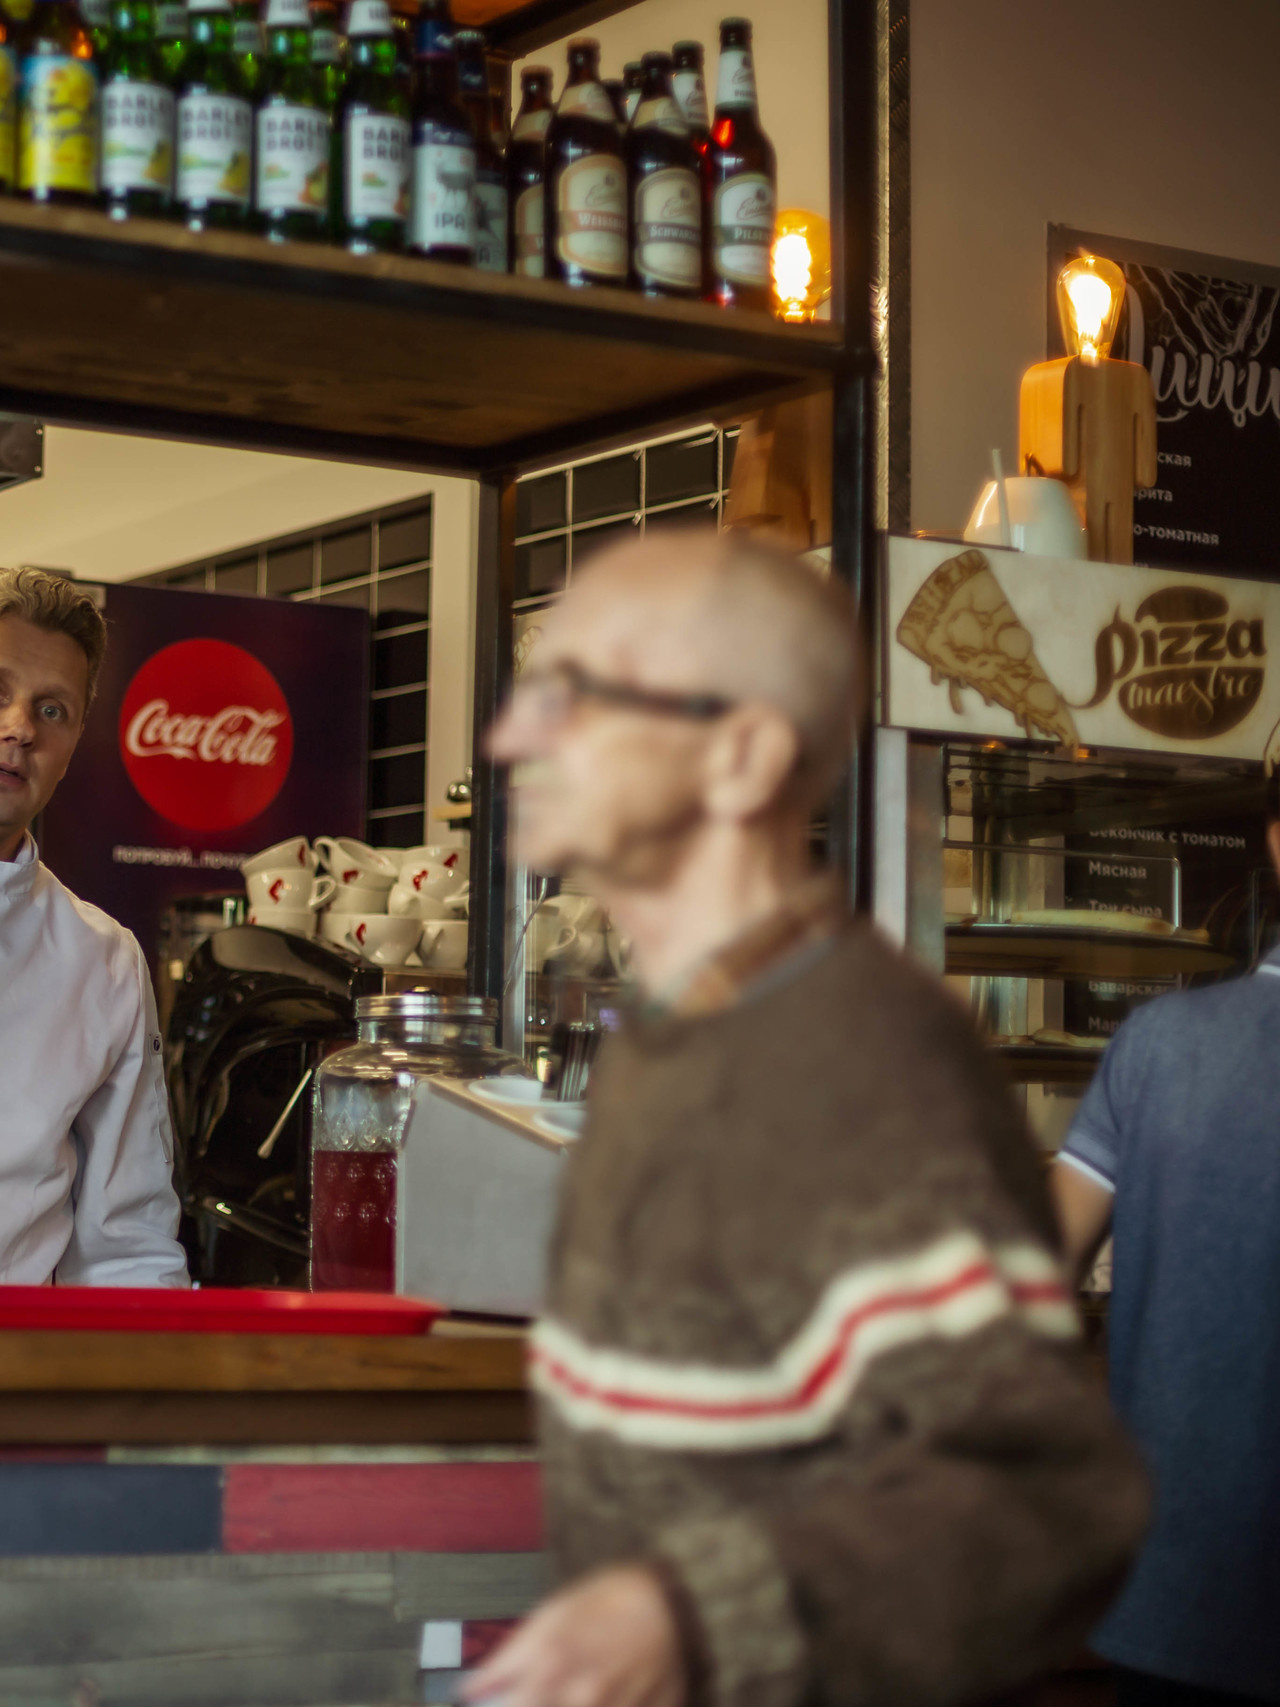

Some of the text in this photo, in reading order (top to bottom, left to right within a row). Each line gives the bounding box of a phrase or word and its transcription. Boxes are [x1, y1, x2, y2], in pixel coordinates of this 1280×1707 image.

[433, 212, 466, 231] IPA
[1157, 452, 1192, 467] ская
[1134, 488, 1173, 502] рита
[1133, 523, 1220, 545] о-томатная
[1127, 667, 1254, 724] maestro
[1088, 860, 1148, 879] Мясная
